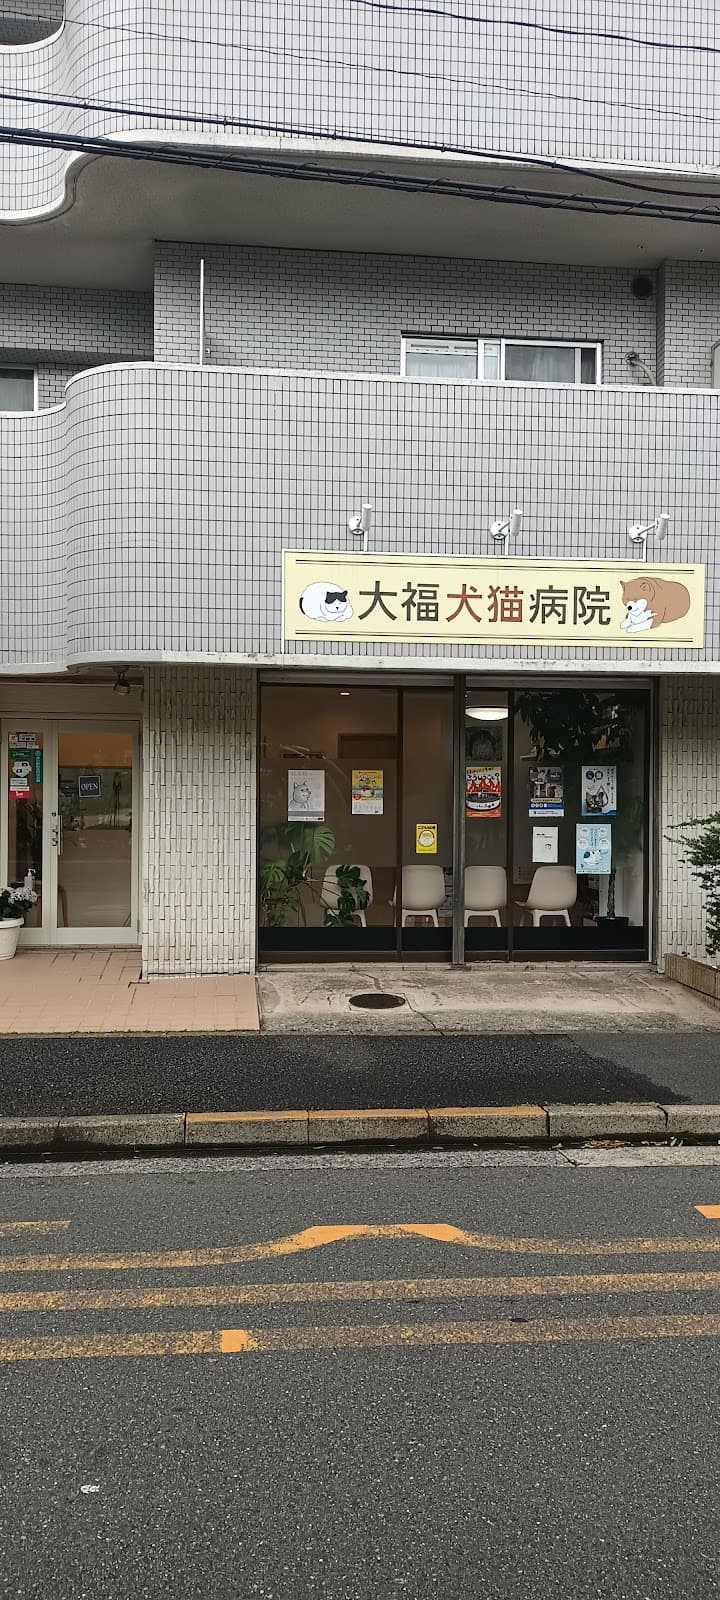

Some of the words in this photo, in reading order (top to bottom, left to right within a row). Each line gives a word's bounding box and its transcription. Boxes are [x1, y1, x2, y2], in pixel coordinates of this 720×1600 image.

[358, 580, 611, 626] 大福犬猫病院
[81, 782, 98, 791] OPEN
